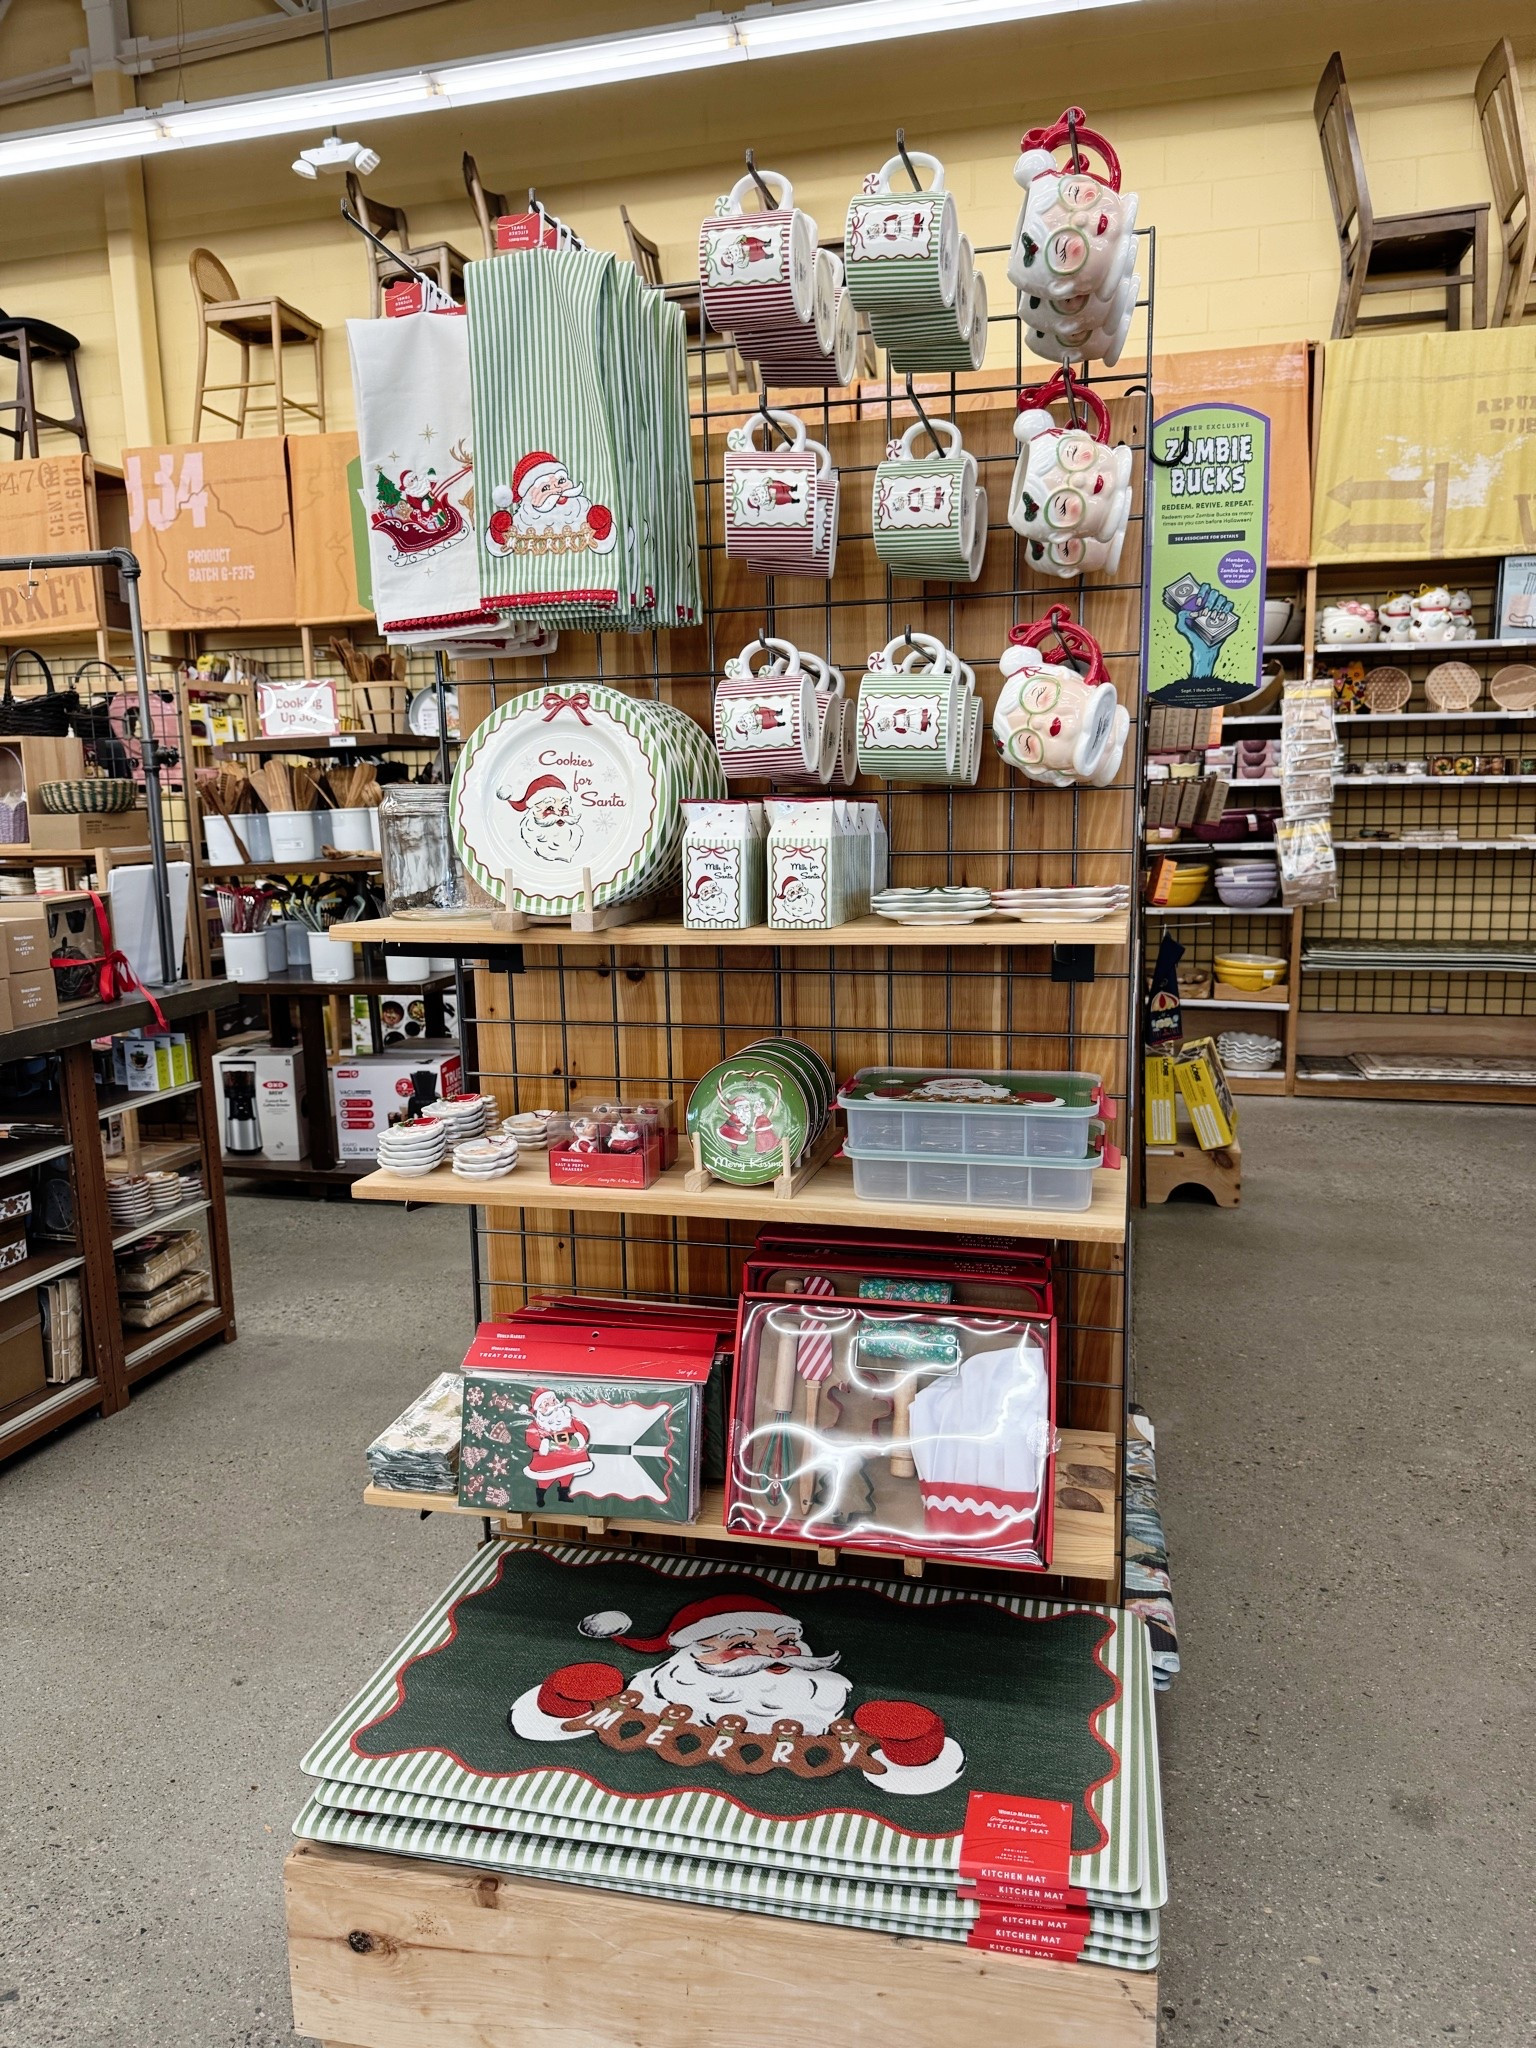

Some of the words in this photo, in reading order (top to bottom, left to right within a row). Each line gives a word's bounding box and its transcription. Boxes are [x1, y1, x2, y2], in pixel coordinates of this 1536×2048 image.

[1206, 422, 1250, 430] EXCLUSIVE
[1165, 434, 1253, 466] ZOMBIE
[1171, 464, 1246, 496] BUCKS
[506, 532, 590, 549] MERRY
[188, 548, 231, 564] PRODUCT
[188, 566, 219, 582] BATCH
[220, 565, 255, 582] G-F375
[280, 713, 296, 725] Up
[538, 750, 594, 768] Cookies
[573, 770, 592, 792] for
[580, 791, 627, 808] Santa
[704, 862, 722, 871] Milk
[723, 862, 732, 874] for
[790, 862, 808, 871] Milk
[809, 862, 818, 874] for
[714, 872, 734, 880] Santa
[800, 872, 821, 880] Santa
[711, 1156, 746, 1172] Merry
[750, 1158, 784, 1168] Kissma
[585, 1708, 860, 1764] MERRY
[986, 1822, 1027, 1832] KITCHEN
[981, 1868, 1022, 1881] KITCHEN
[1026, 1874, 1047, 1884] MAT
[999, 1886, 1040, 1897] KITCHEN
[1044, 1891, 1064, 1900] MAT
[1002, 1916, 1044, 1926] KITCHEN
[996, 1929, 1037, 1942] KITCHEN
[1041, 1935, 1061, 1944] MAT
[989, 1944, 1031, 1955] KITCHEN
